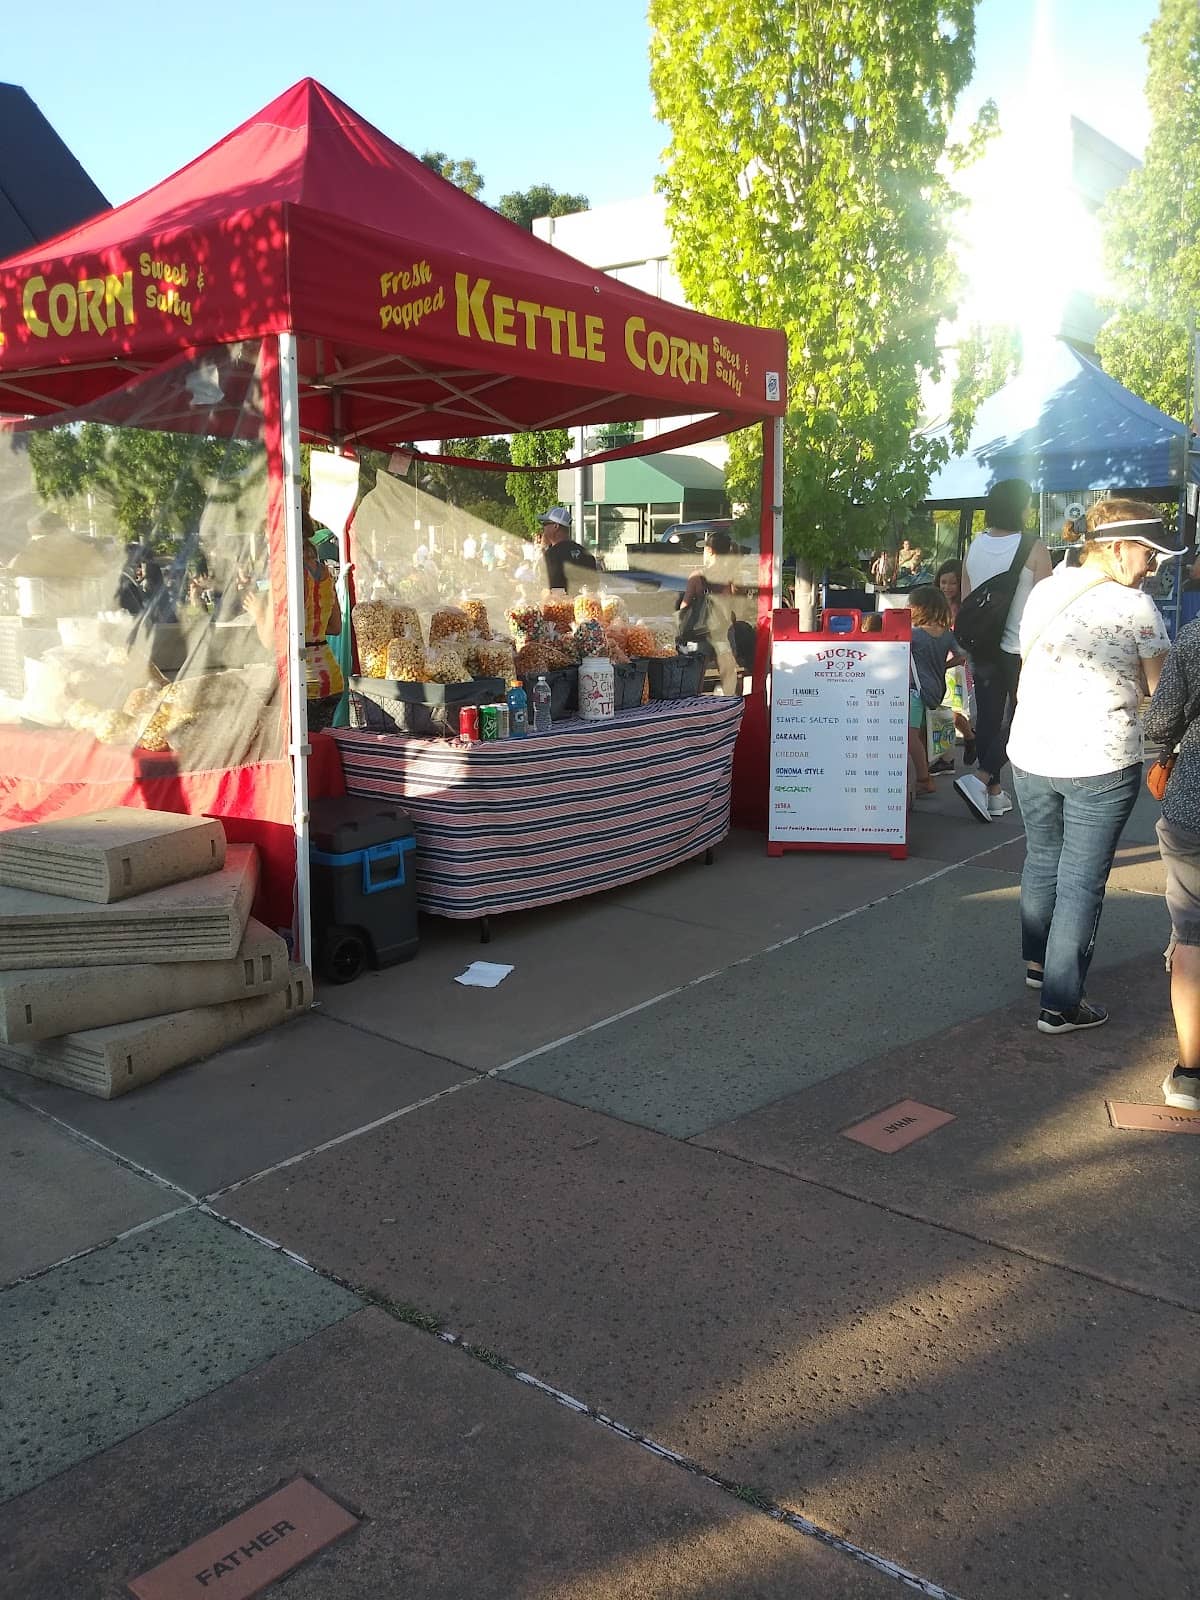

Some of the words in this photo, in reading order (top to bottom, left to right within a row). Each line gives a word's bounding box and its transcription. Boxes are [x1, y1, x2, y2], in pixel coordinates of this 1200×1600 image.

[140, 252, 189, 287] Sweet
[379, 260, 433, 298] Fresh
[22, 271, 135, 338] CORN
[145, 285, 193, 325] Salty
[379, 287, 446, 331] Popped
[454, 272, 606, 364] KETTLE
[624, 316, 709, 385] CORN
[712, 335, 741, 372] Sweet
[715, 362, 742, 397] Salty
[816, 648, 867, 661] LUCKY
[775, 732, 807, 741] CARAMEL
[776, 716, 806, 724] SIMPLE
[809, 716, 839, 724] SALTED
[775, 767, 802, 775] SONOMA
[882, 1116, 917, 1135] WHAT
[194, 1519, 296, 1587] FATHER
